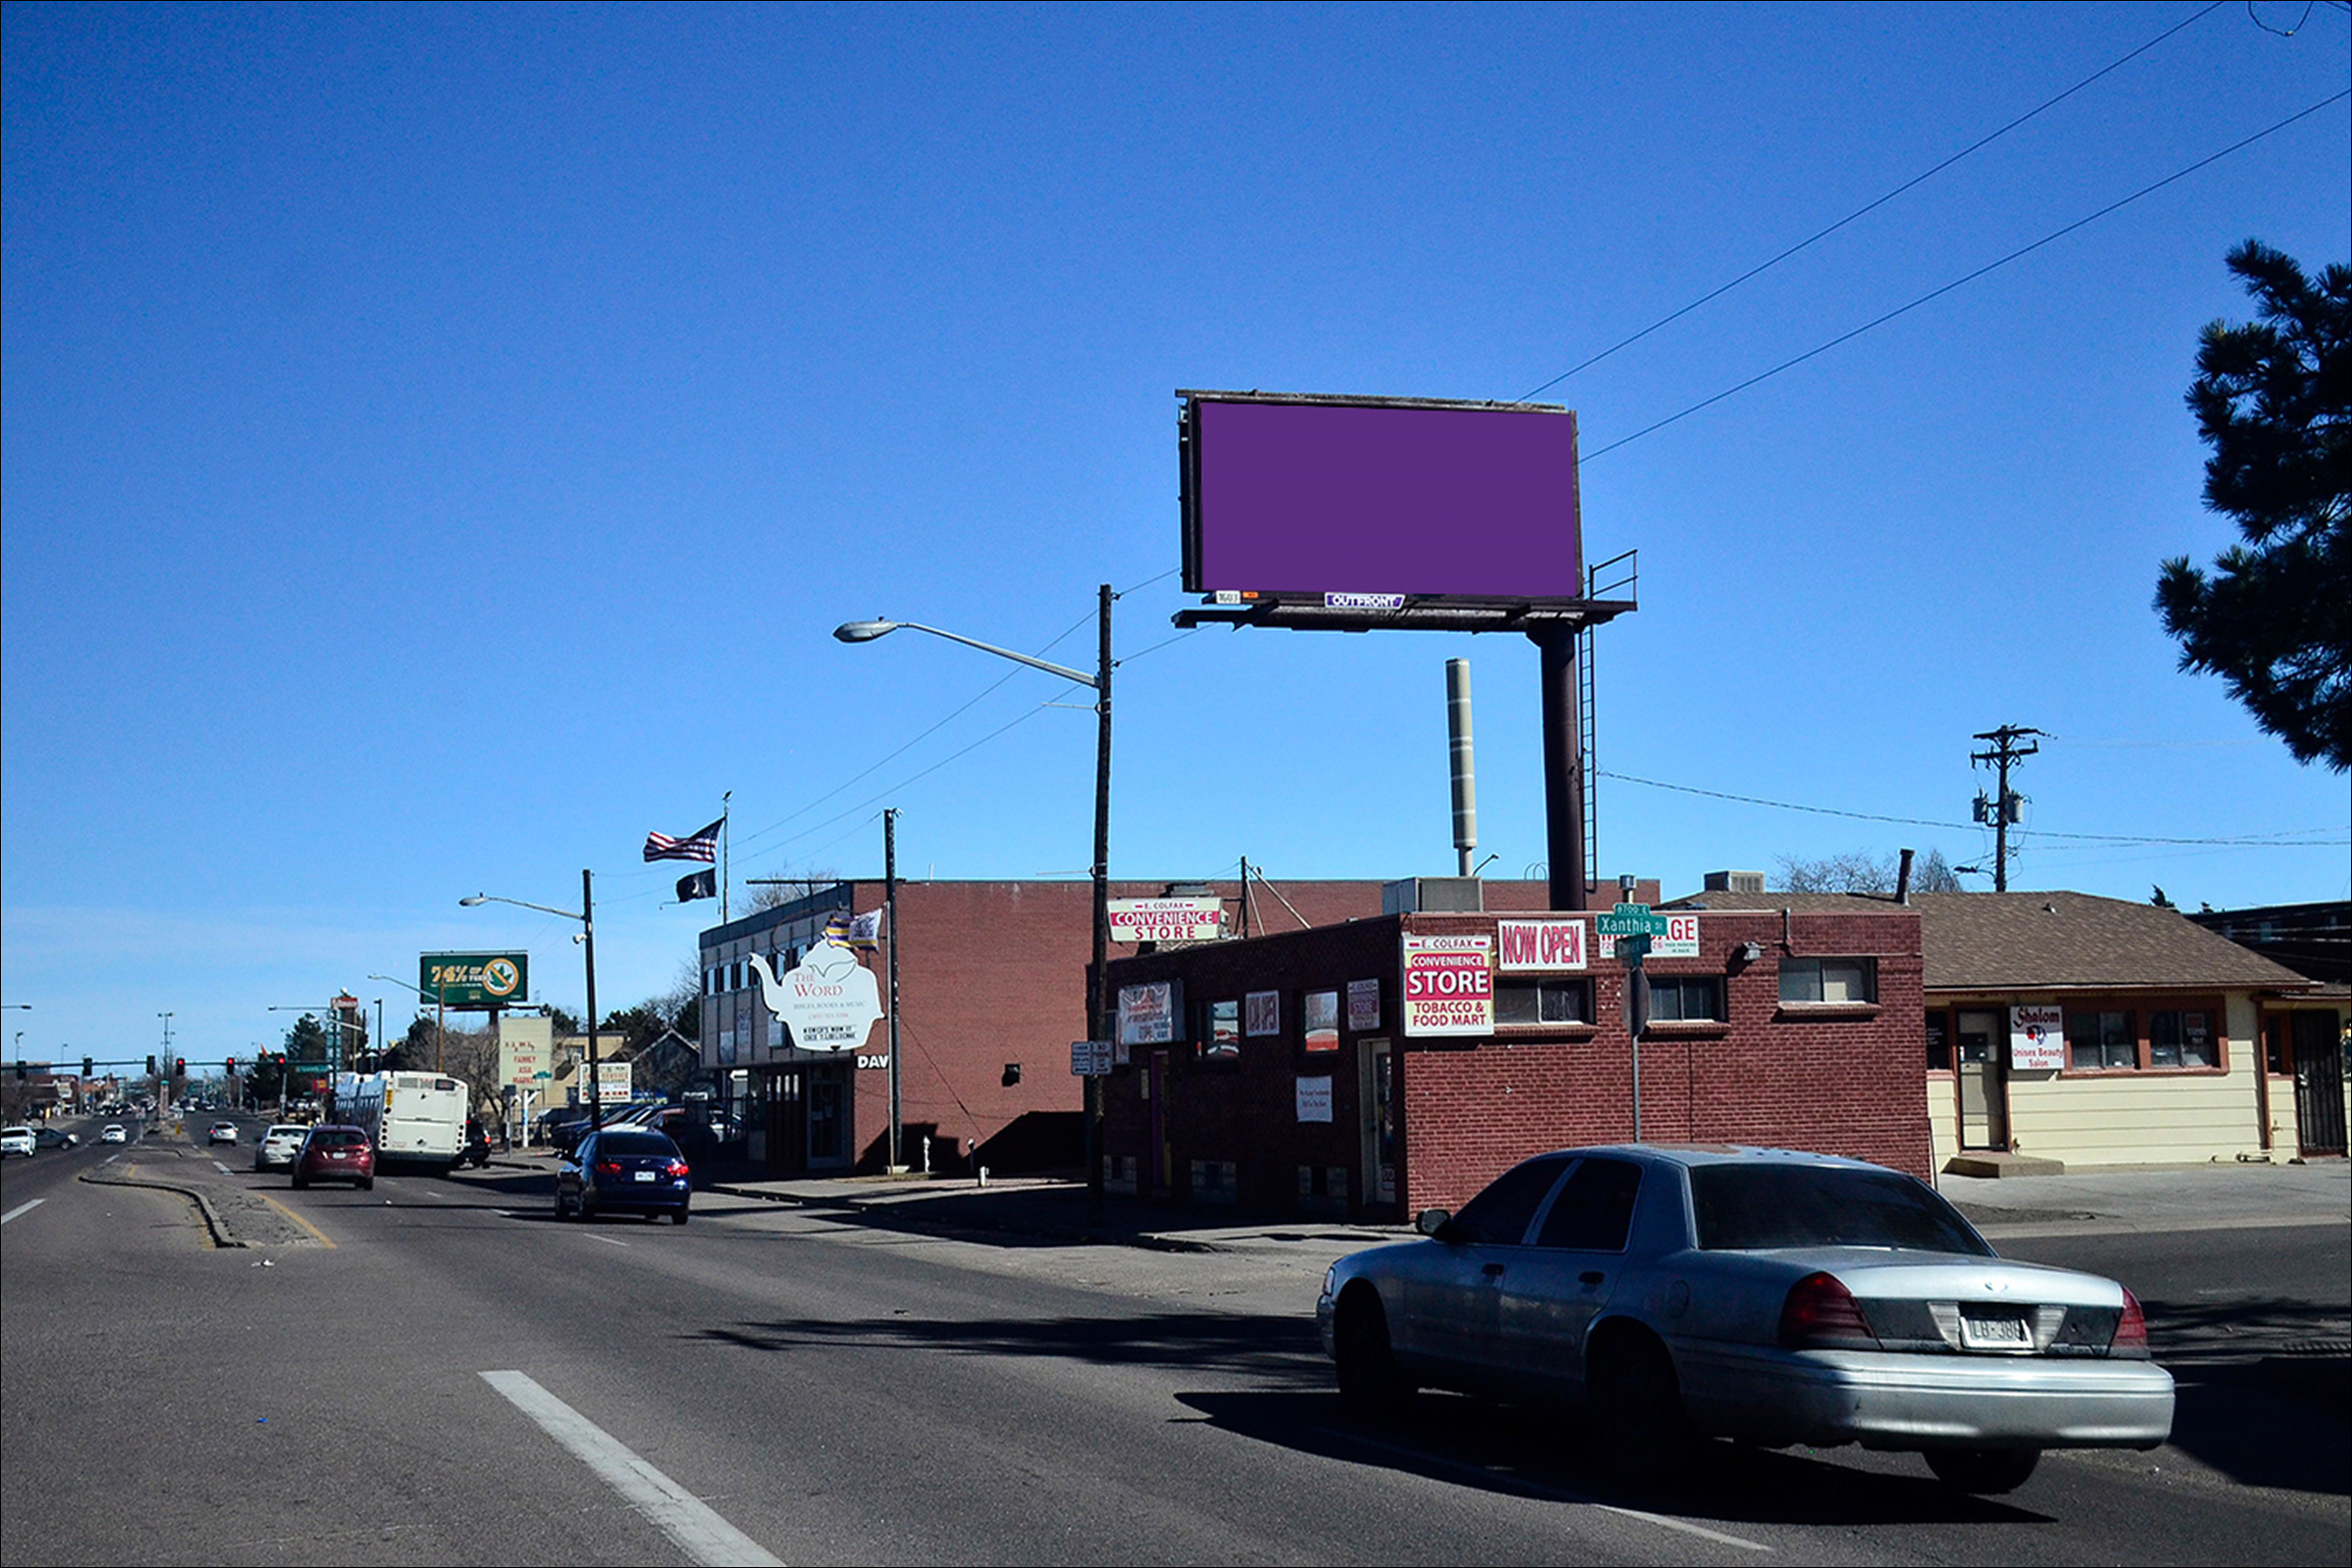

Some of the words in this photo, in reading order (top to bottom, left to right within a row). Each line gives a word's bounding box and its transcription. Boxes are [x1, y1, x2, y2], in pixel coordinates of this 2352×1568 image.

[1332, 594, 1397, 607] OUTFRONT
[1153, 901, 1184, 909] COLFAX
[1116, 911, 1213, 925] CONVENIENCE
[1601, 916, 1651, 932] Xanthia
[1135, 925, 1196, 940] STORE
[1433, 939, 1472, 949] COLFAX
[1502, 925, 1538, 963] NOW
[1541, 925, 1581, 963] OPEN
[1412, 956, 1483, 967] CONVENIENCE
[794, 973, 815, 982] THE
[1408, 970, 1489, 994] STORE
[795, 984, 844, 998] WORD
[1414, 1002, 1473, 1013] TOBACCO
[1474, 1002, 1485, 1013] &
[1413, 1015, 1448, 1026] FOOD
[1451, 1014, 1486, 1026] MART
[2013, 1006, 2060, 1028] Shalom
[2038, 1048, 2064, 1058] Beauty
[858, 1055, 889, 1069] DAV
[2029, 1058, 2049, 1067] Salon
